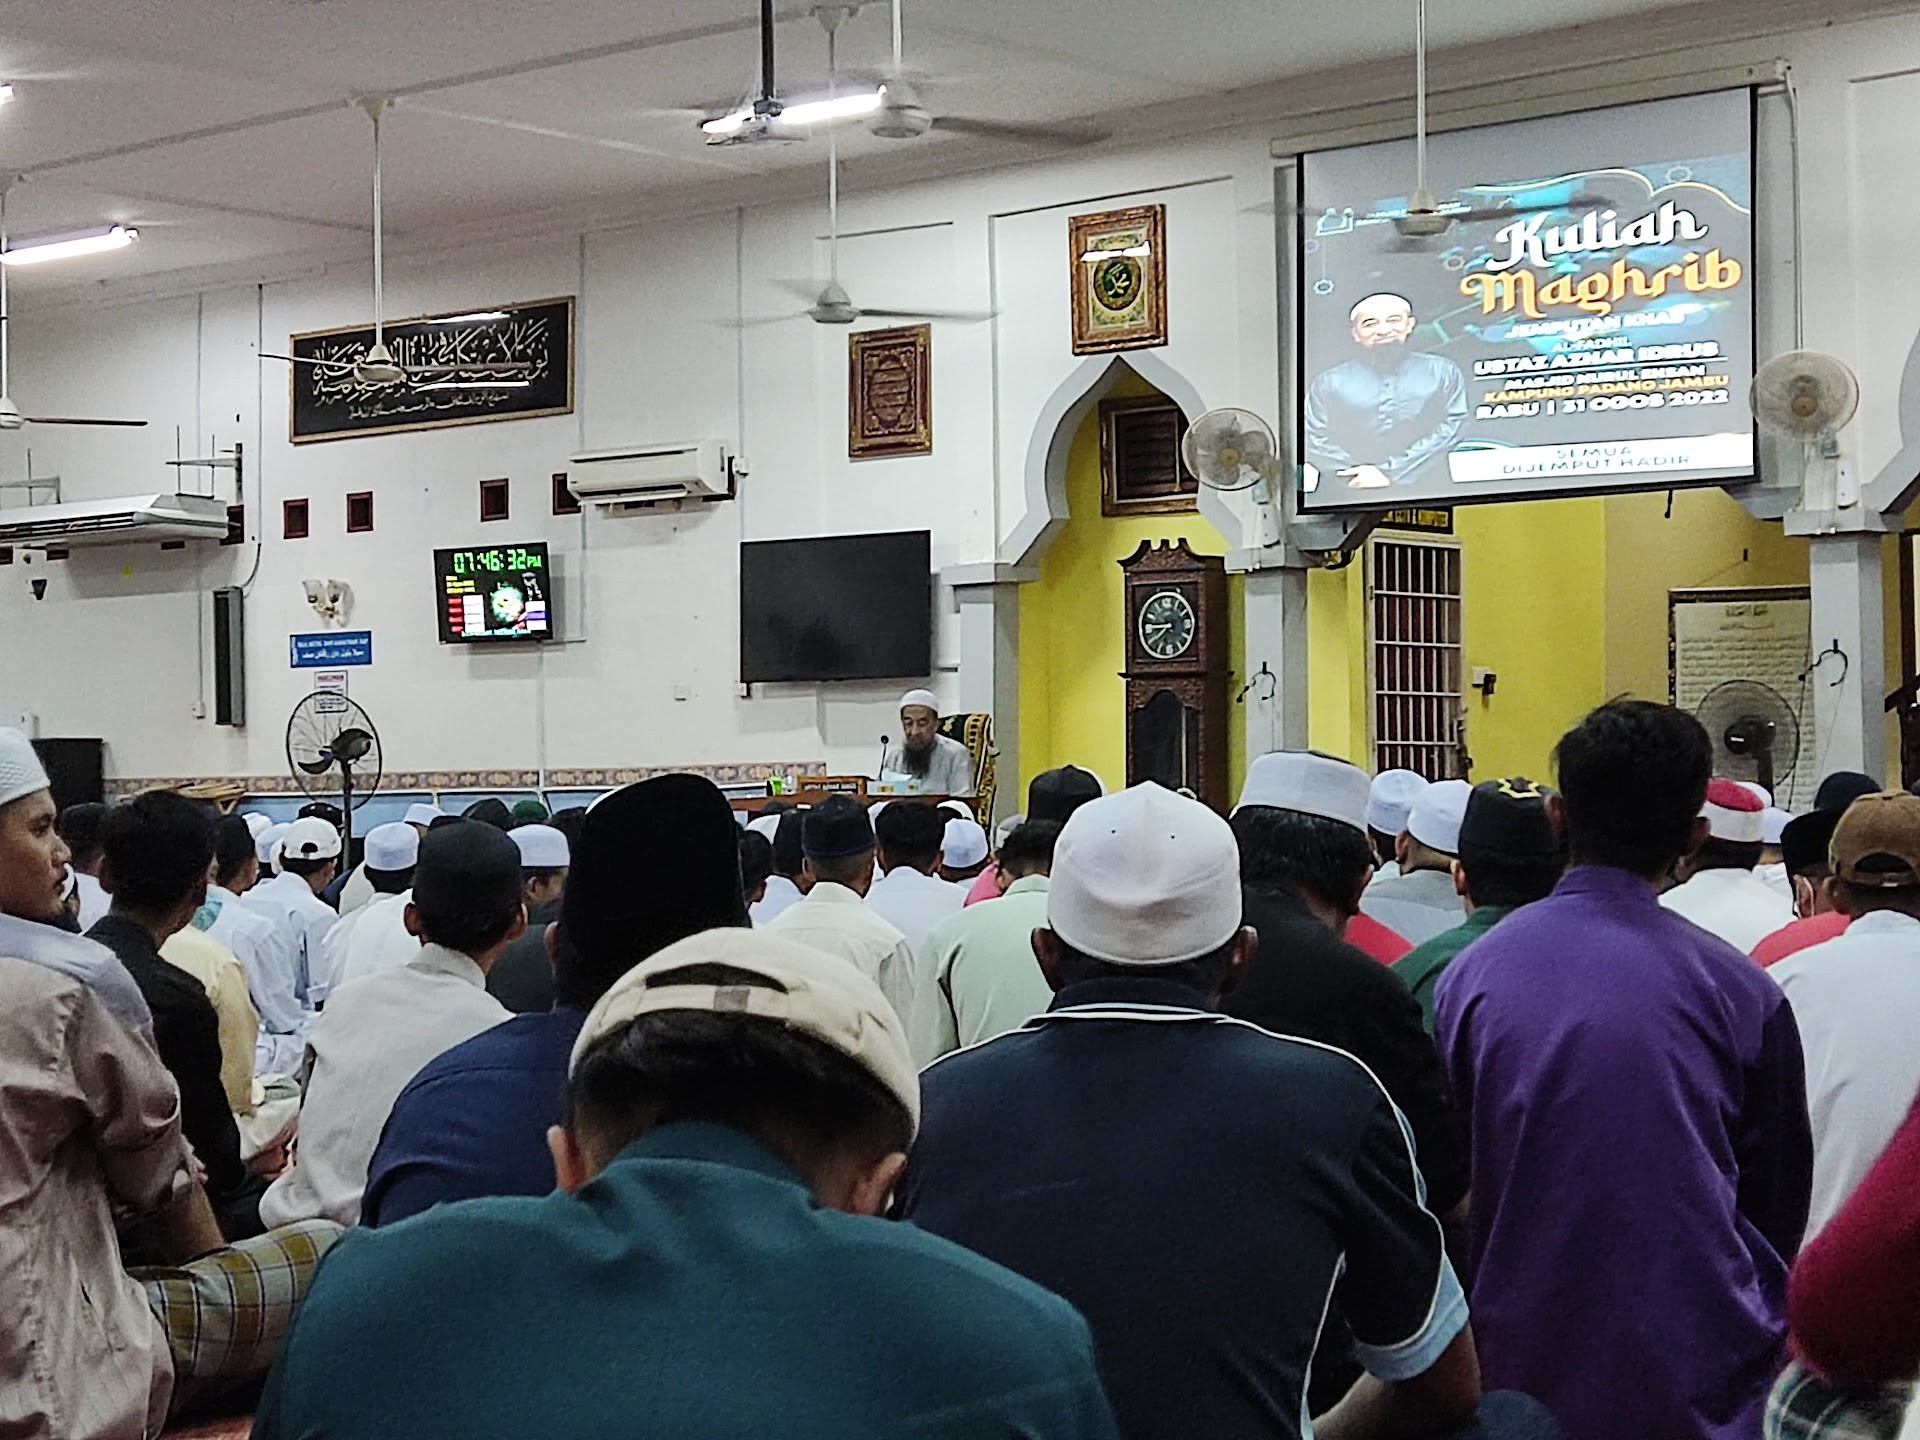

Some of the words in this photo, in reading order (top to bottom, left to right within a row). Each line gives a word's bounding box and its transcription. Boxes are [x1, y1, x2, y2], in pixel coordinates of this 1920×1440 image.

[1485, 200, 1709, 272] Kuliah
[1460, 248, 1742, 319] Maghrib
[1505, 316, 1622, 339] JEMPUTAN
[1474, 354, 1549, 375] USTAZ
[1549, 349, 1635, 369] AZHAR
[1638, 341, 1720, 361] IDRUS
[1484, 386, 1575, 403] KAMPUNG
[1579, 380, 1656, 395] PADANG
[1659, 375, 1729, 390] JAMBU
[1504, 372, 1575, 391] MASJID
[1476, 401, 1540, 420] RABU
[1561, 398, 1587, 414] 31
[1668, 389, 1729, 408] 2022
[1502, 459, 1611, 474] DIJEMPUT
[1620, 455, 1691, 468] HADIR
[1557, 446, 1633, 459] SEMUA
